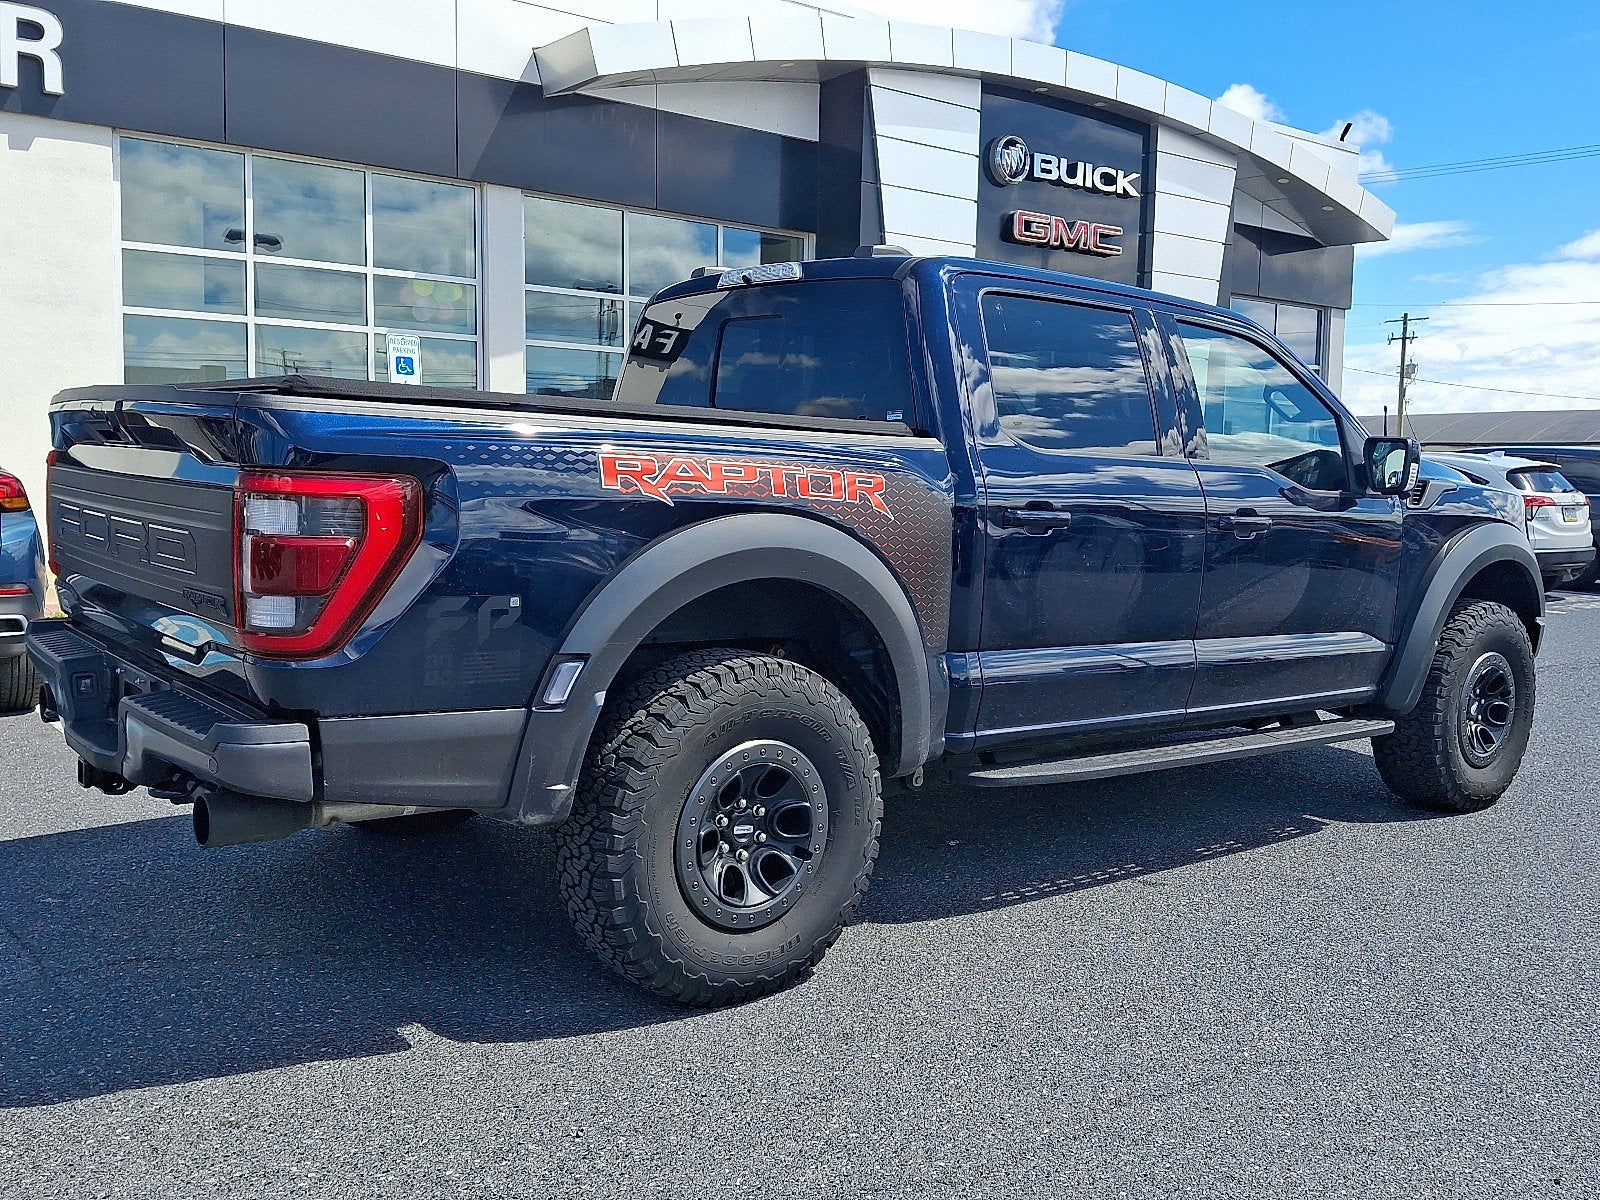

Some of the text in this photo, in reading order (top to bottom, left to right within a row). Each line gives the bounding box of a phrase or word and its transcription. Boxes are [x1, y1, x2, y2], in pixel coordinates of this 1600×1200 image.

[0, 1, 64, 95] R
[1033, 152, 1142, 198] BUICK
[1013, 209, 1124, 255] GMC
[389, 337, 418, 347] RESERVED
[392, 346, 416, 355] PARKING
[598, 452, 895, 521] RAPTOR
[57, 502, 198, 576] FORD
